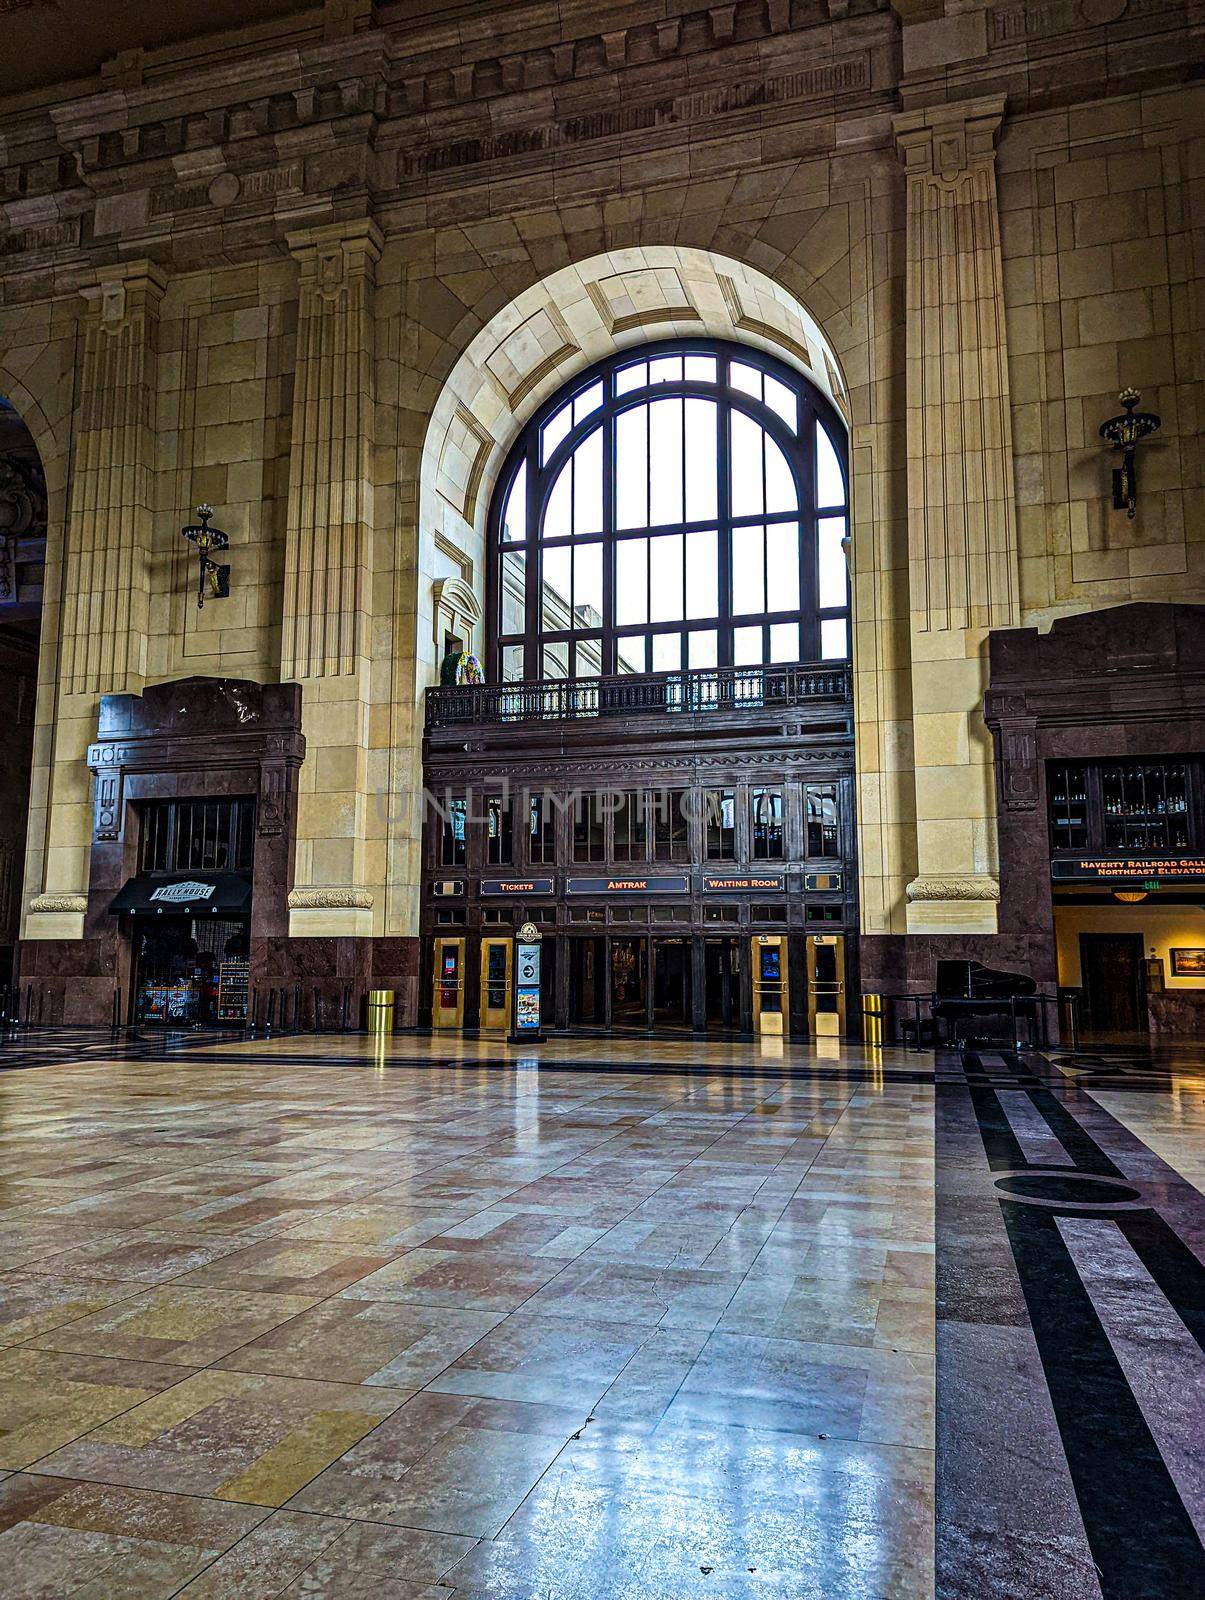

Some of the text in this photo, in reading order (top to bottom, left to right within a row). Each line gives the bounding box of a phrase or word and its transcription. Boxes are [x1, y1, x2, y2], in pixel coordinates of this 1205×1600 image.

[1080, 861, 1125, 869] HAVERTY
[1128, 860, 1177, 869] RAILROAD
[1098, 867, 1155, 876] NORTHEAST
[500, 883, 534, 891] TICKETS
[607, 881, 647, 889] AMTRAK
[709, 879, 778, 888] WAITING ROOM
[155, 887, 211, 898] RALLY HOUSE
